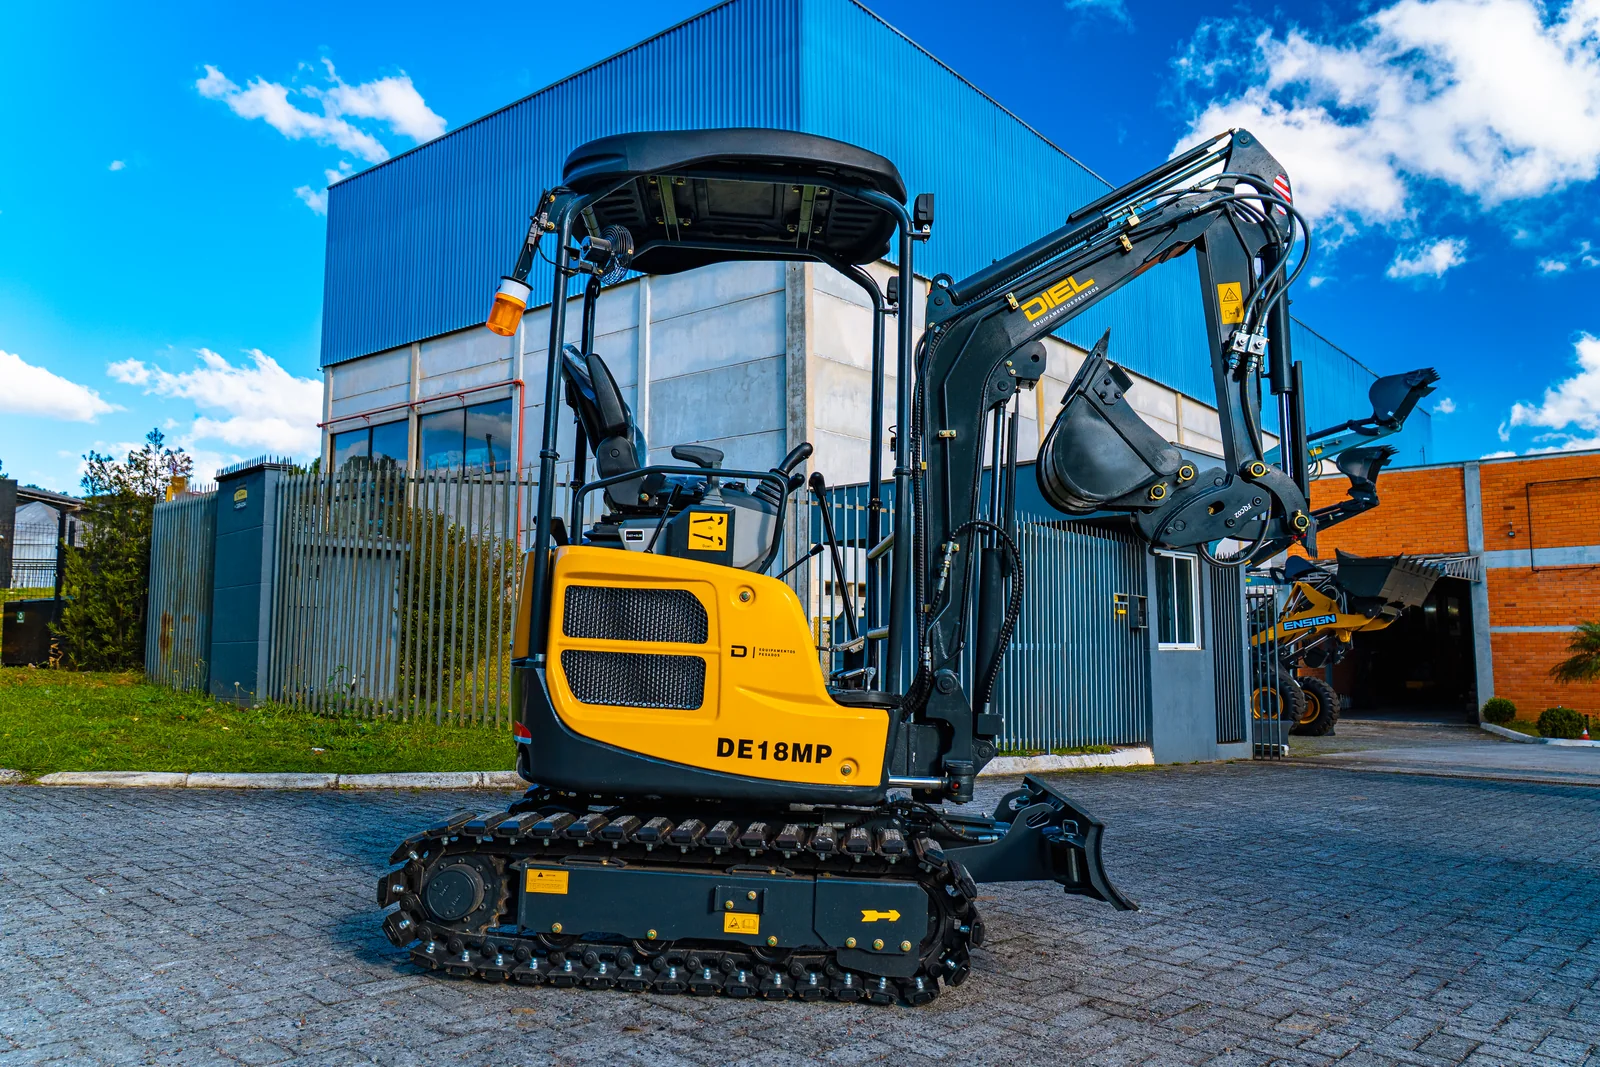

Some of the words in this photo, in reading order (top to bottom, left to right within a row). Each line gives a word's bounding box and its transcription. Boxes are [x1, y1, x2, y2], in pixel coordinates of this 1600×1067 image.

[1020, 275, 1095, 322] DIEL
[1032, 300, 1075, 328] EQUIPAMENTOS
[1075, 286, 1099, 303] PESADOS
[1283, 614, 1336, 630] ENSIGN
[716, 737, 832, 764] DE18MP
